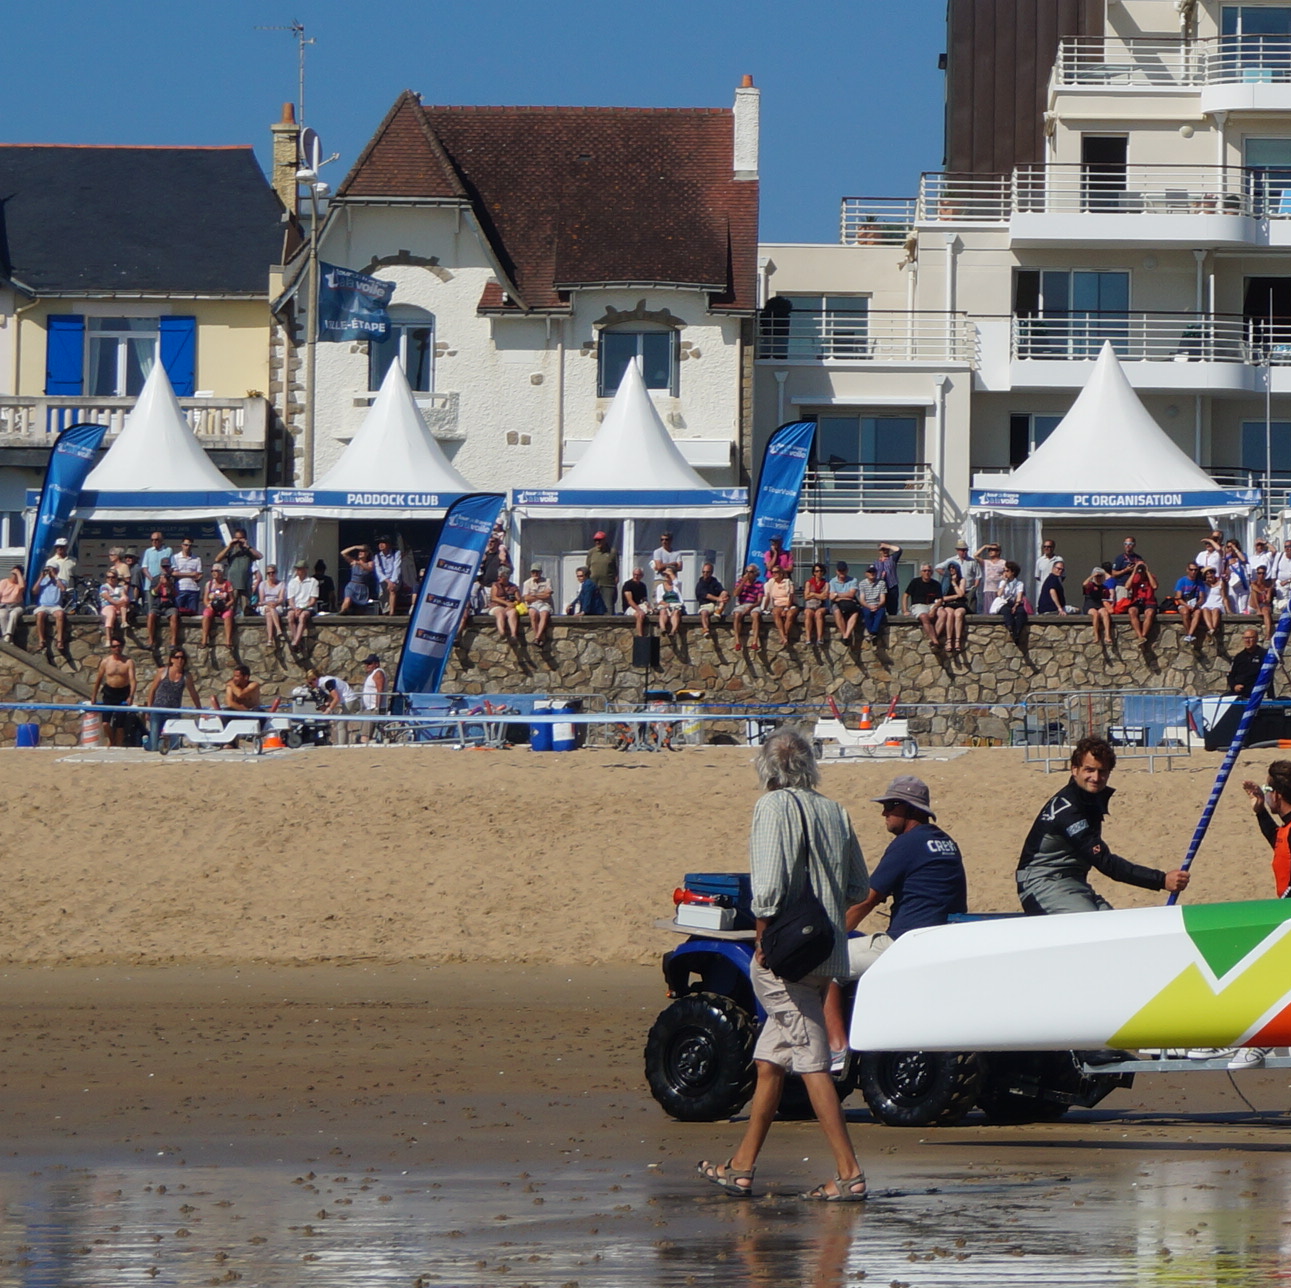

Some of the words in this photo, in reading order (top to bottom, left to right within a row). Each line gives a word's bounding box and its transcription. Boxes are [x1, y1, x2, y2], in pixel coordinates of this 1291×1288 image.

[347, 493, 405, 505] PADDOCK
[408, 494, 439, 506] CLUB
[1073, 494, 1090, 506] PC
[1091, 493, 1182, 506] ORGANISATION
